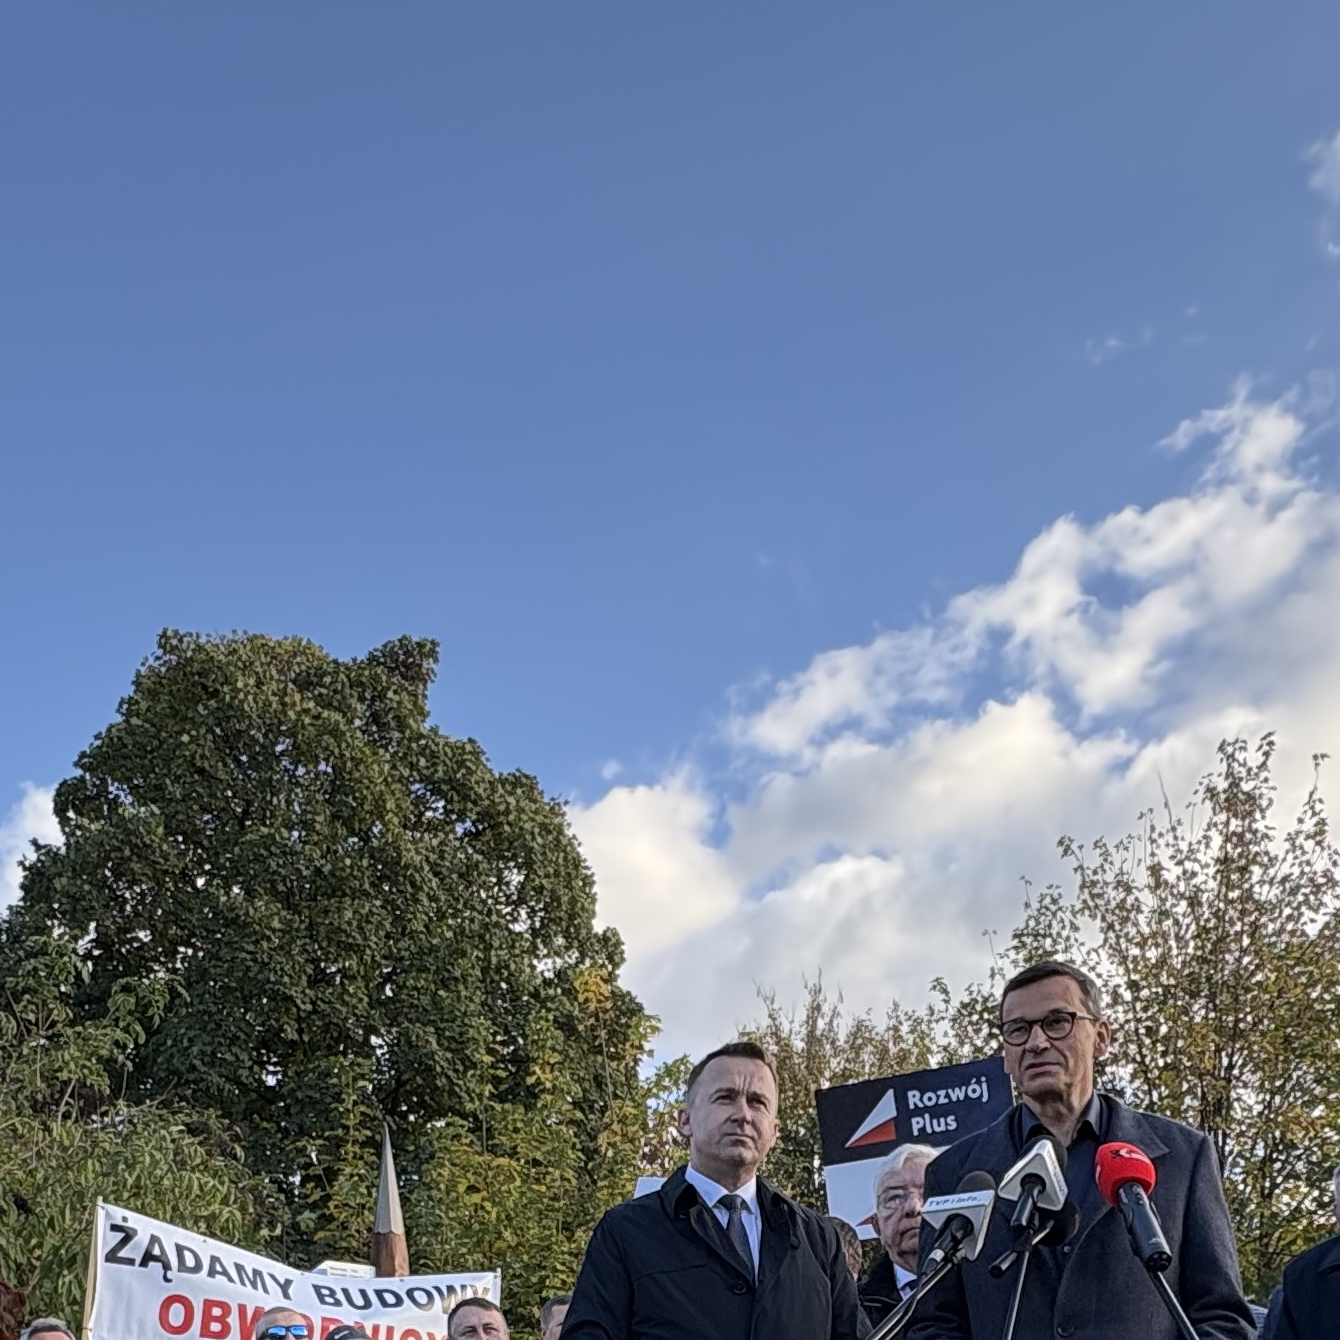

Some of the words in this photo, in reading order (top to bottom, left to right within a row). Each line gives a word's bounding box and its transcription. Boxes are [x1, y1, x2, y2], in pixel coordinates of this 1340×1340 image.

[906, 1076, 990, 1110] Rozwój
[910, 1113, 958, 1137] Plus
[104, 1216, 294, 1301] ŻĄDAMY
